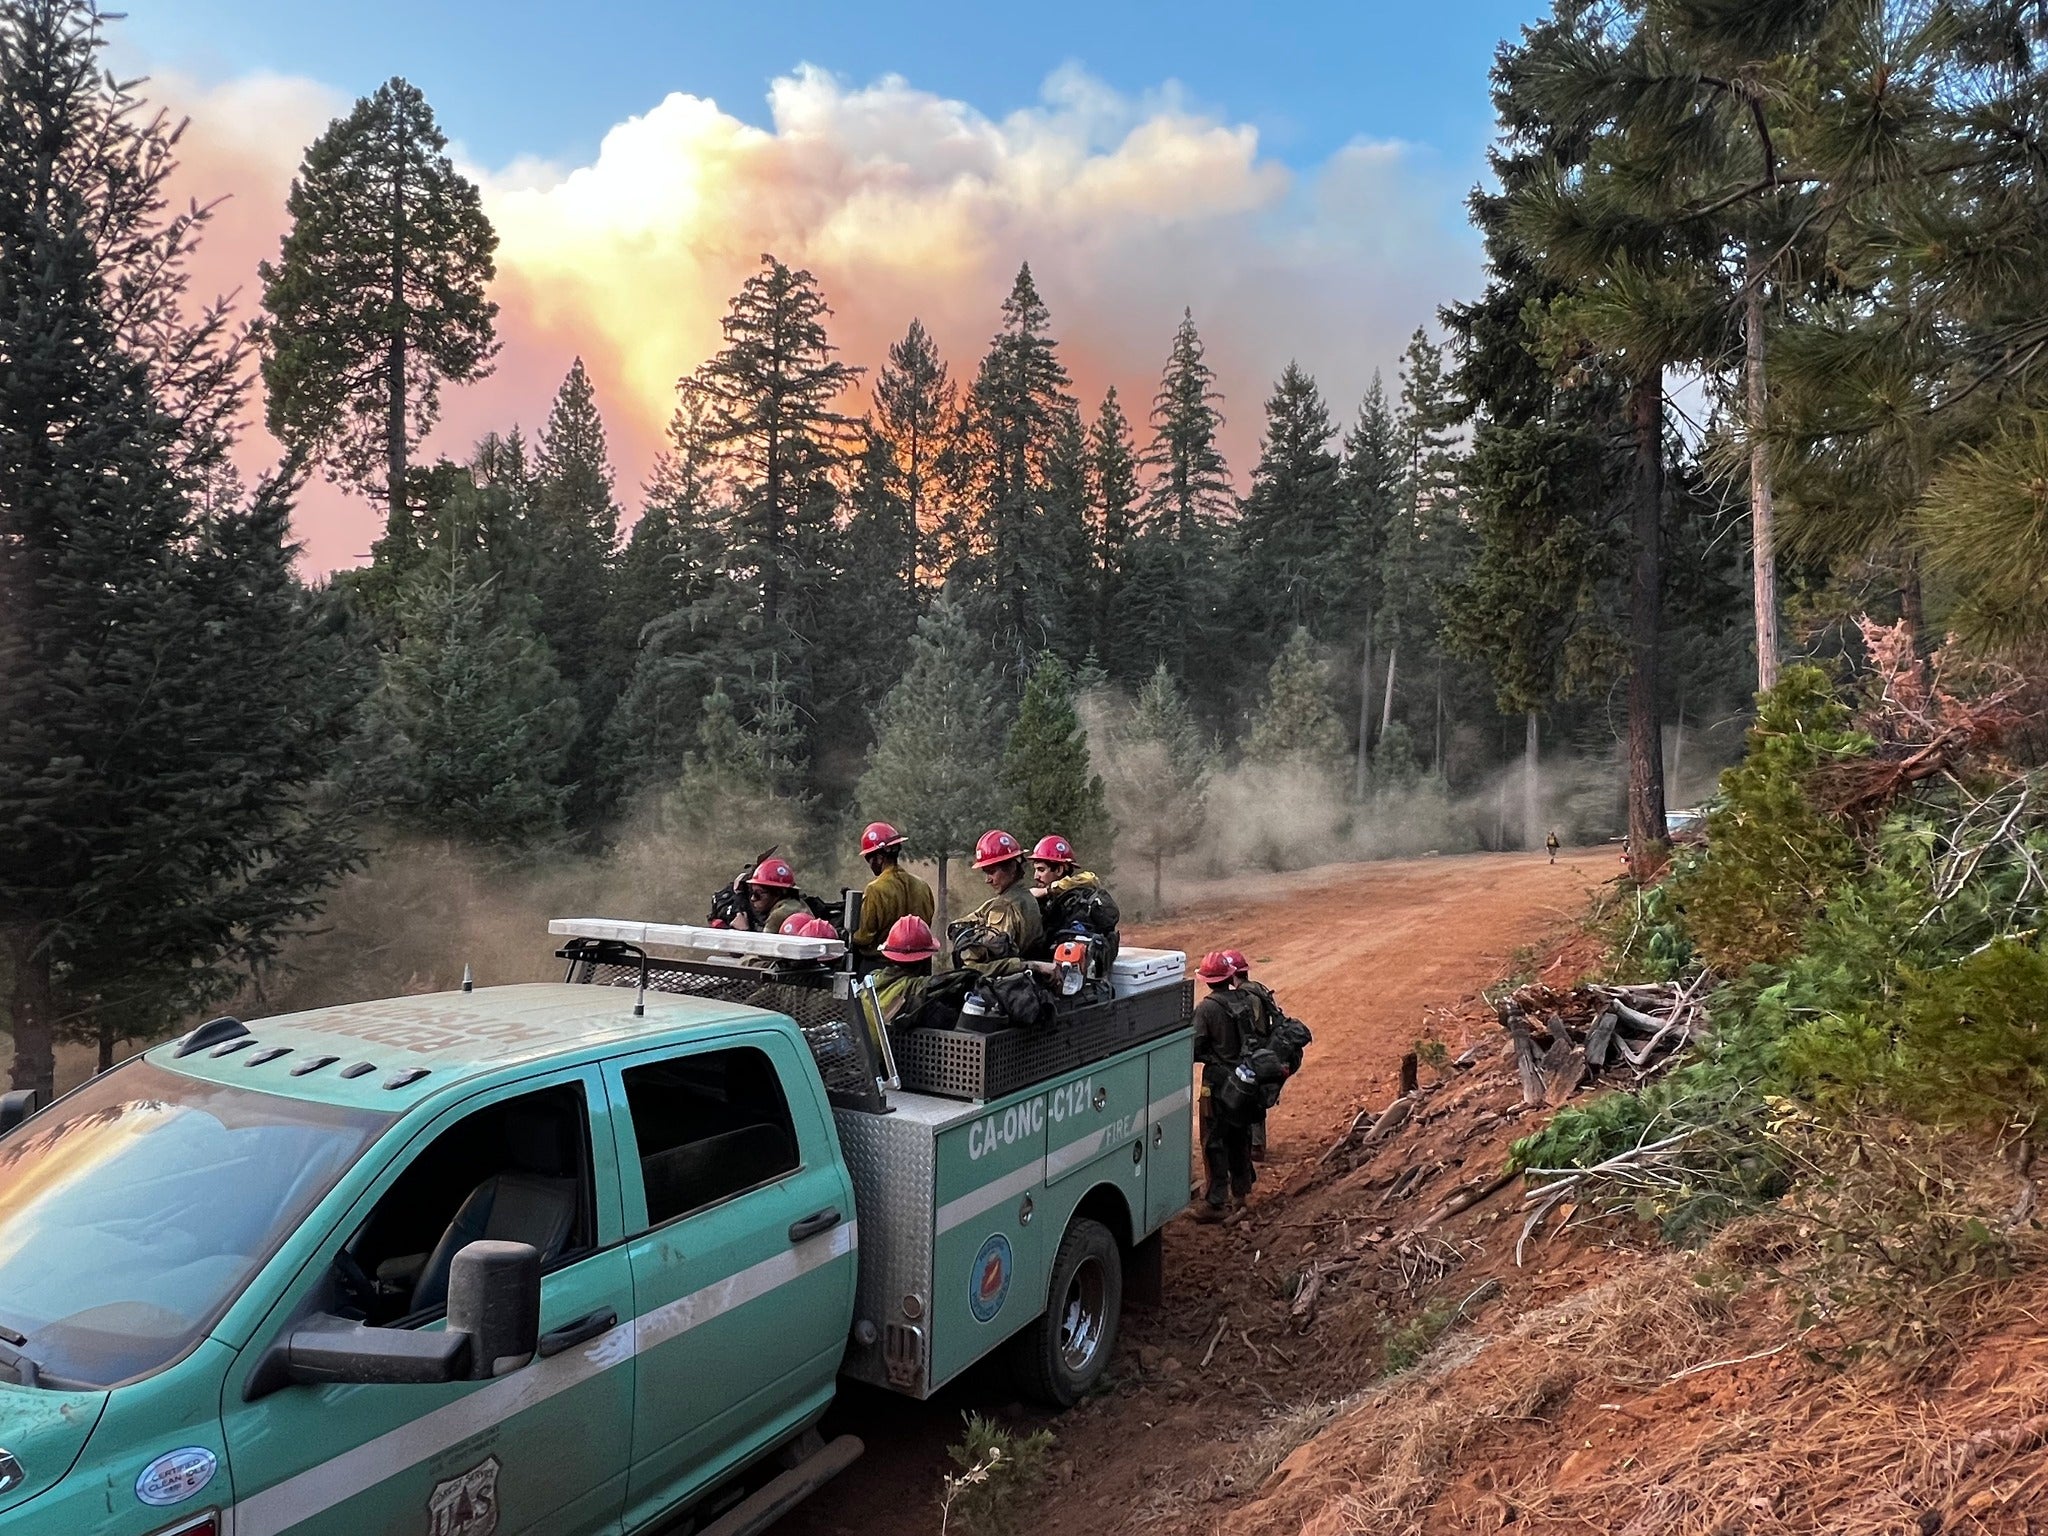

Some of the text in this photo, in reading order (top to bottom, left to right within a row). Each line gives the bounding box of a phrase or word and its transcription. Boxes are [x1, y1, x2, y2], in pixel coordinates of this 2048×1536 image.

[279, 1013, 480, 1053] REDDING
[1105, 1115, 1130, 1146] FIRE
[152, 1459, 200, 1481] CERTIFIED
[148, 1475, 182, 1492] CLEAN
